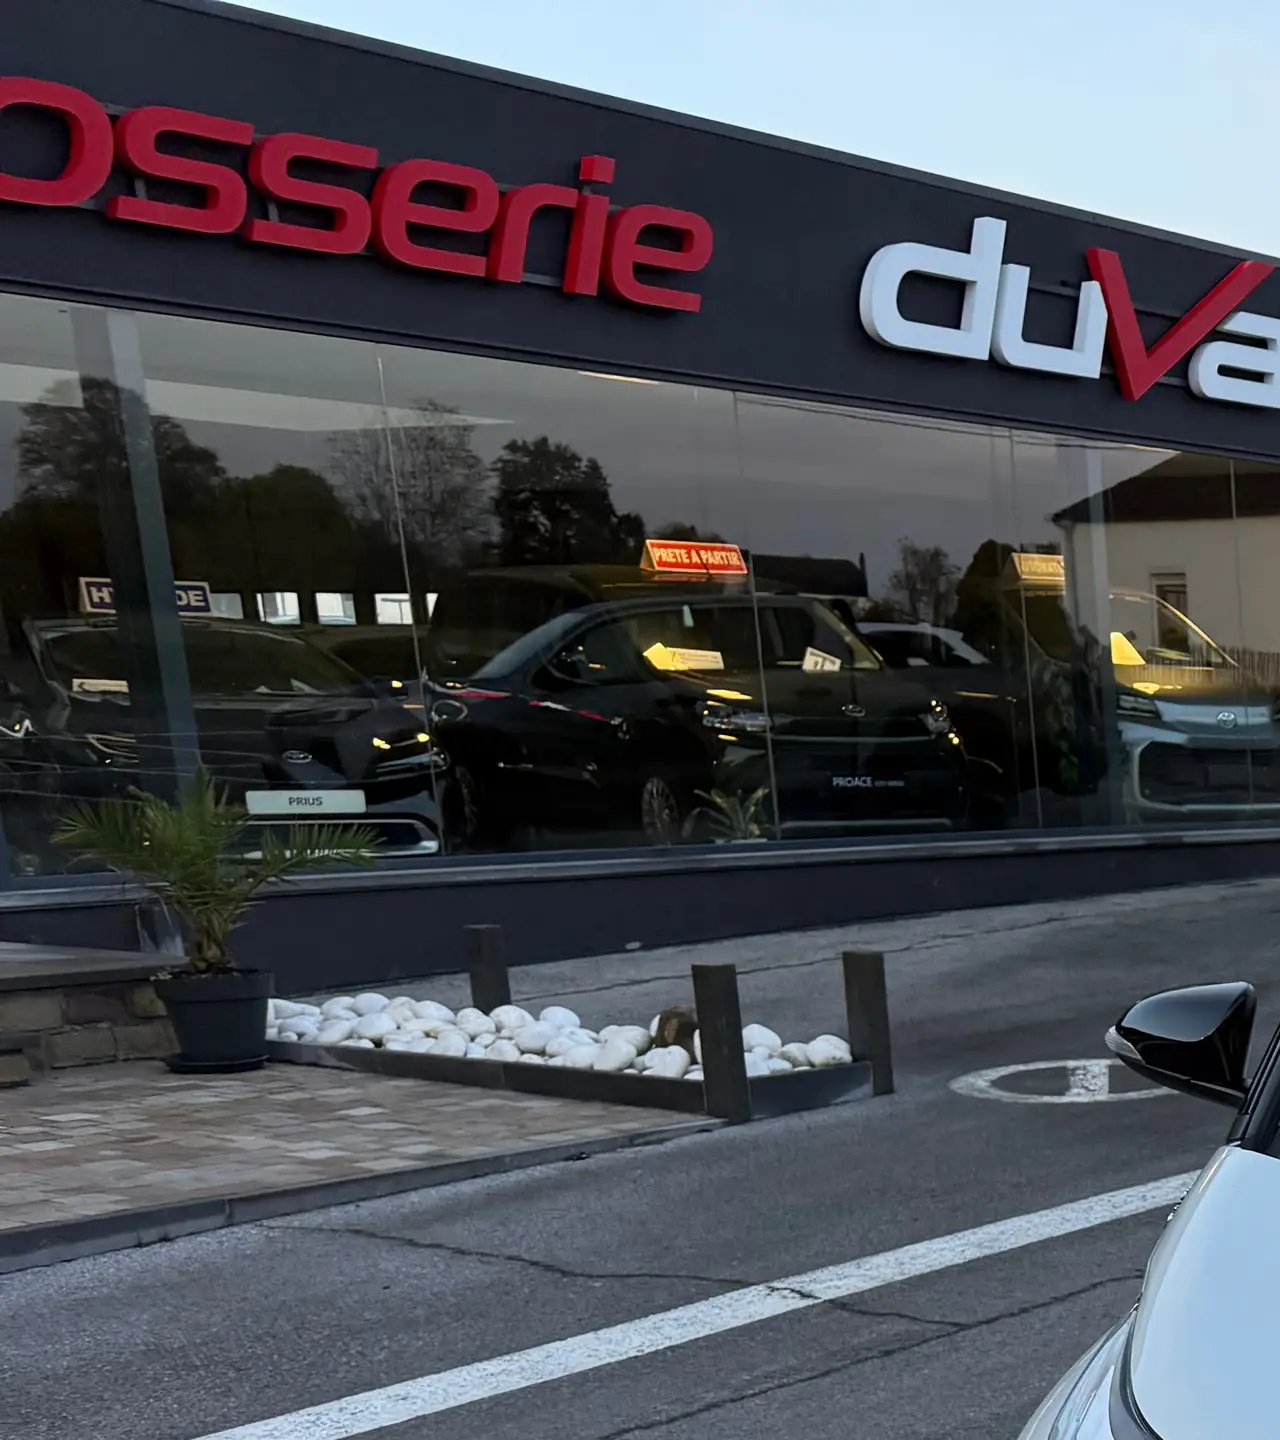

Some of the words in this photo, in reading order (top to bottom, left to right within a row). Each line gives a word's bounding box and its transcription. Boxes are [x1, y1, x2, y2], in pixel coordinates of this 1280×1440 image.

[652, 547, 690, 563] PRETE
[690, 548, 701, 564] A
[700, 550, 740, 565] PARTIR
[832, 776, 873, 787] PROACE
[288, 796, 323, 806] PRIUS
